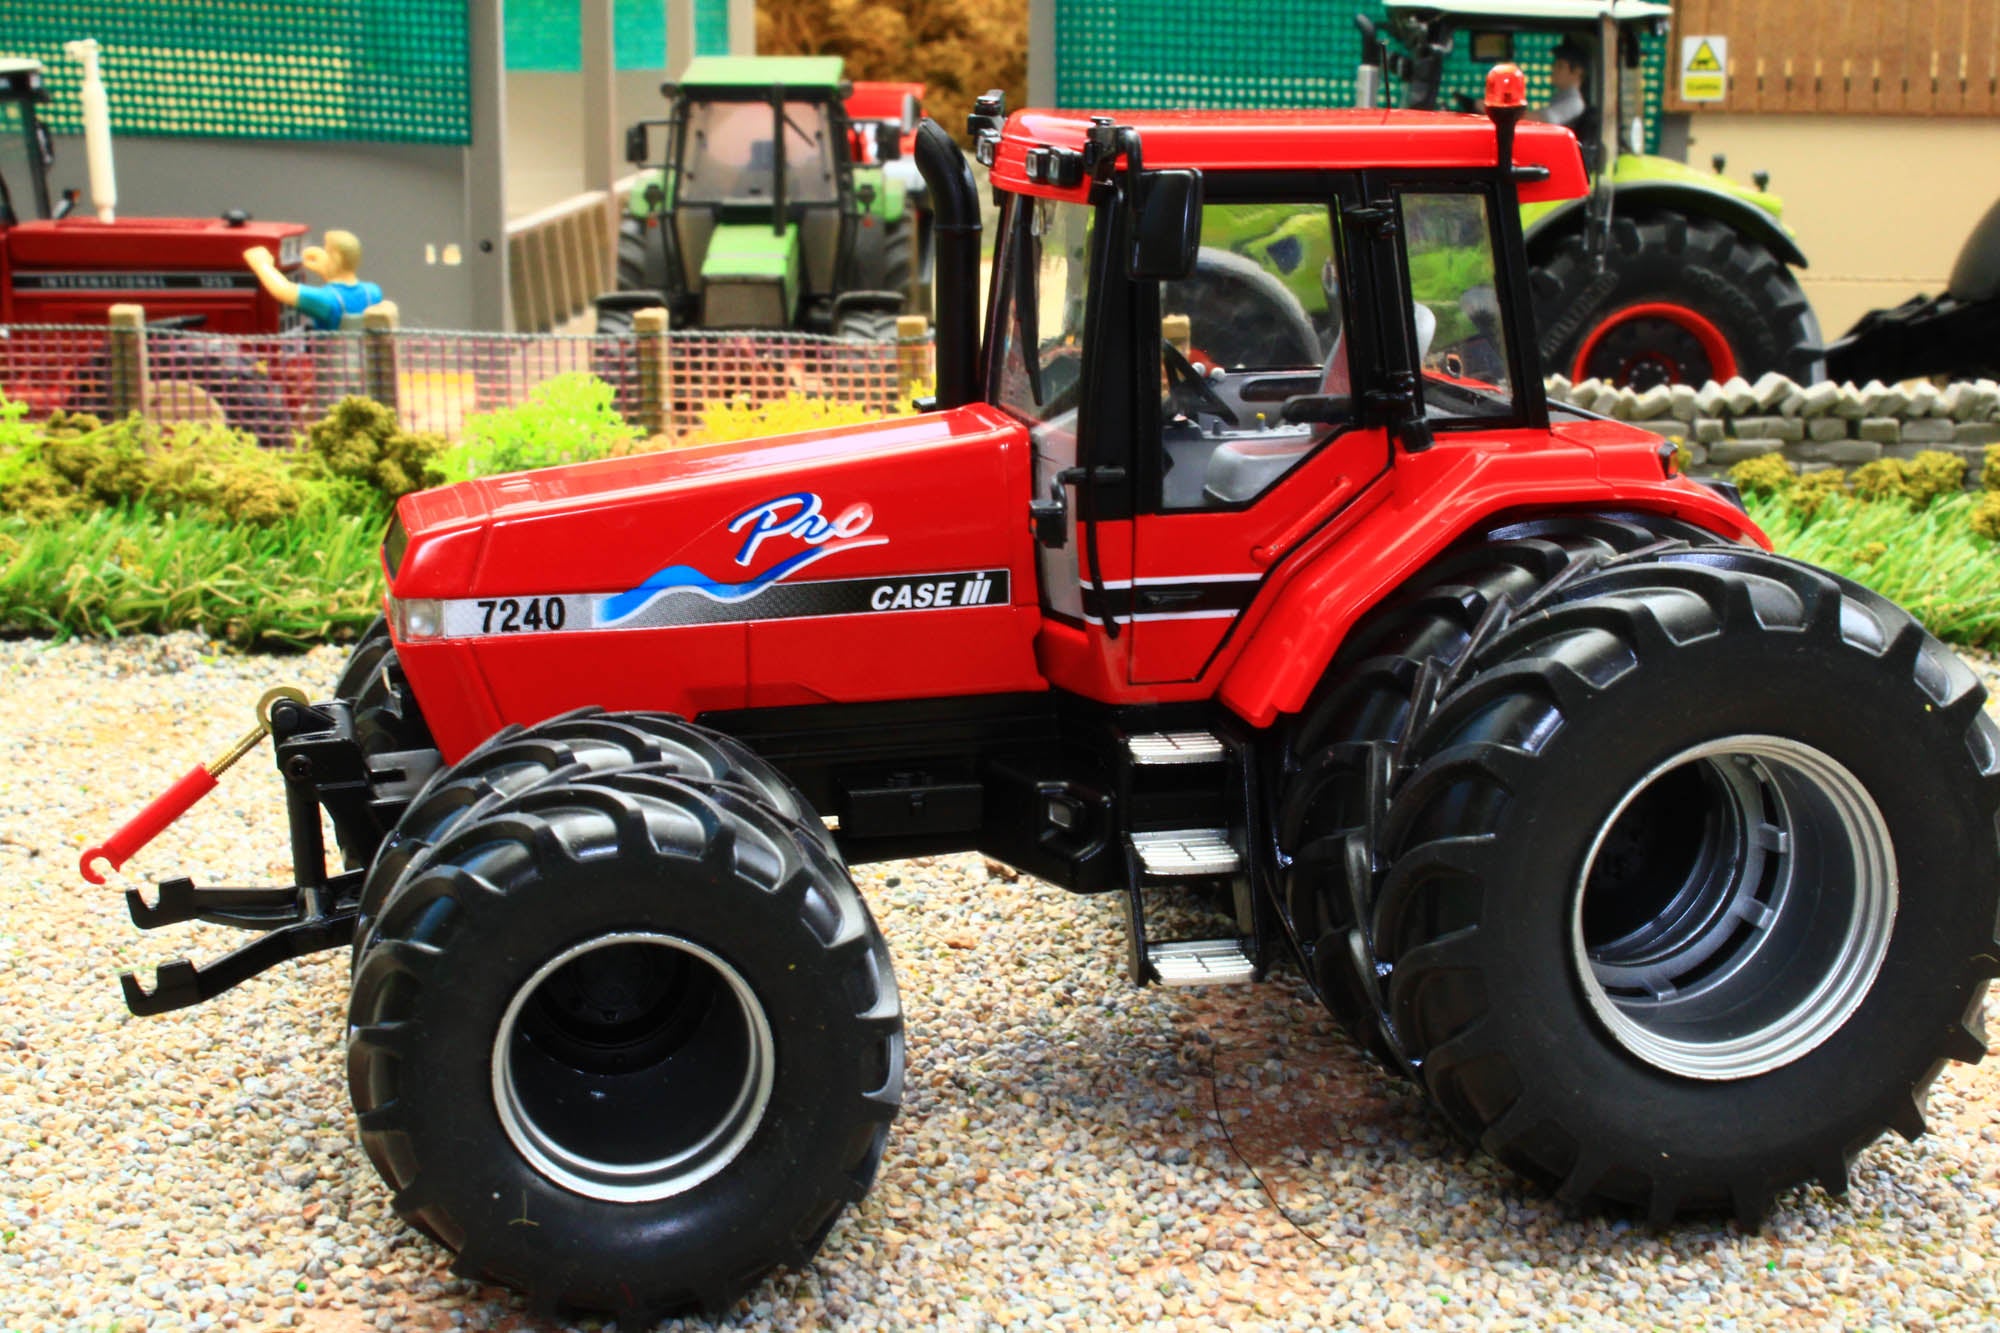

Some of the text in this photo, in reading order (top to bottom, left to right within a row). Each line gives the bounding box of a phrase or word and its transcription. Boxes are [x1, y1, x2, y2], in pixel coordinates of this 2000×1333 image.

[41, 274, 166, 289] INTERNATIONAL
[728, 492, 874, 566] Pro
[871, 582, 956, 610] CASE
[477, 597, 566, 633] 7240
